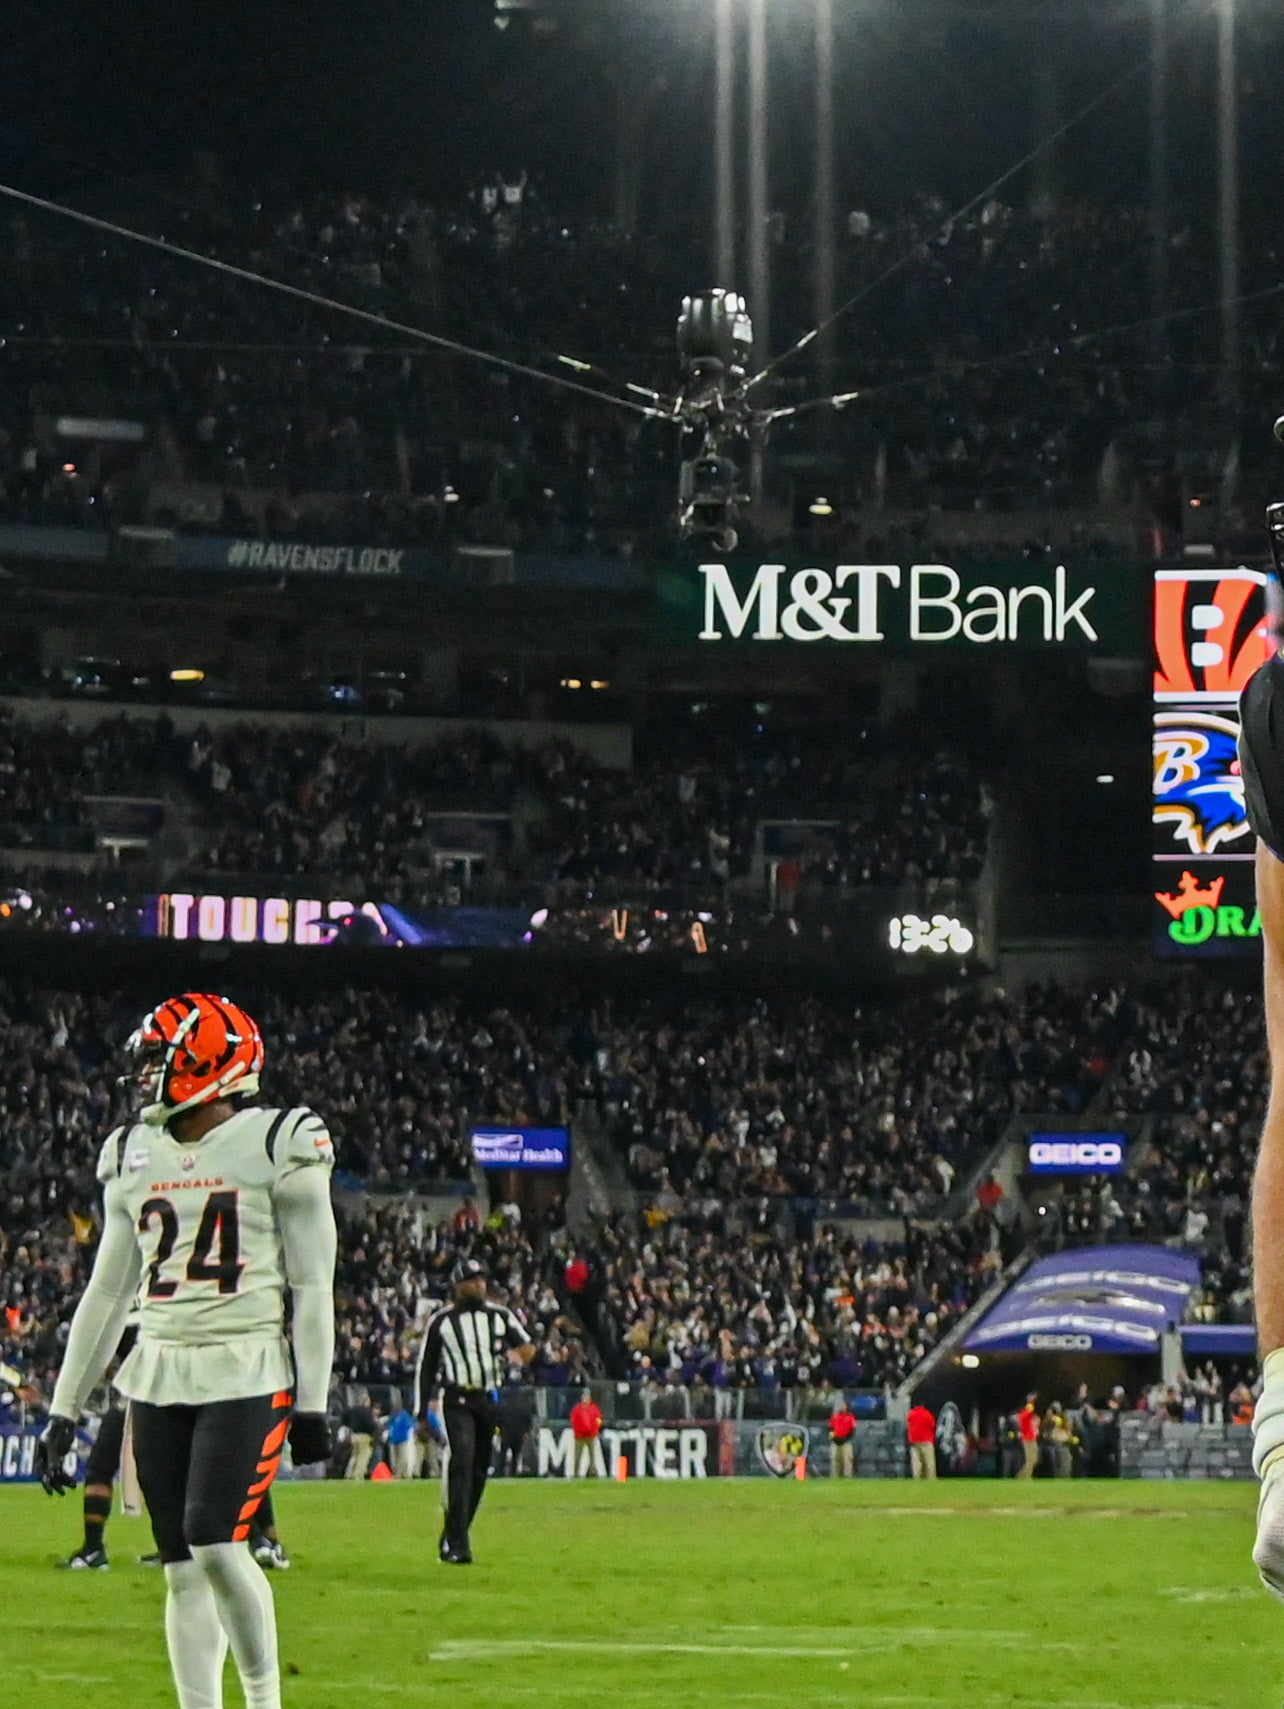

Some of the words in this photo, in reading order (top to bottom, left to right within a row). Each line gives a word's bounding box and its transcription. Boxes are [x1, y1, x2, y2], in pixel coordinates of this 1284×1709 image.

[227, 540, 404, 573] #RAVENSFLOCK
[698, 564, 901, 641] M&T
[910, 564, 1099, 643] Bank
[1029, 1143, 1121, 1165] GEICO
[151, 1176, 225, 1192] BENGALS
[138, 1189, 247, 1299] 24
[1027, 1333, 1093, 1350] GEICO
